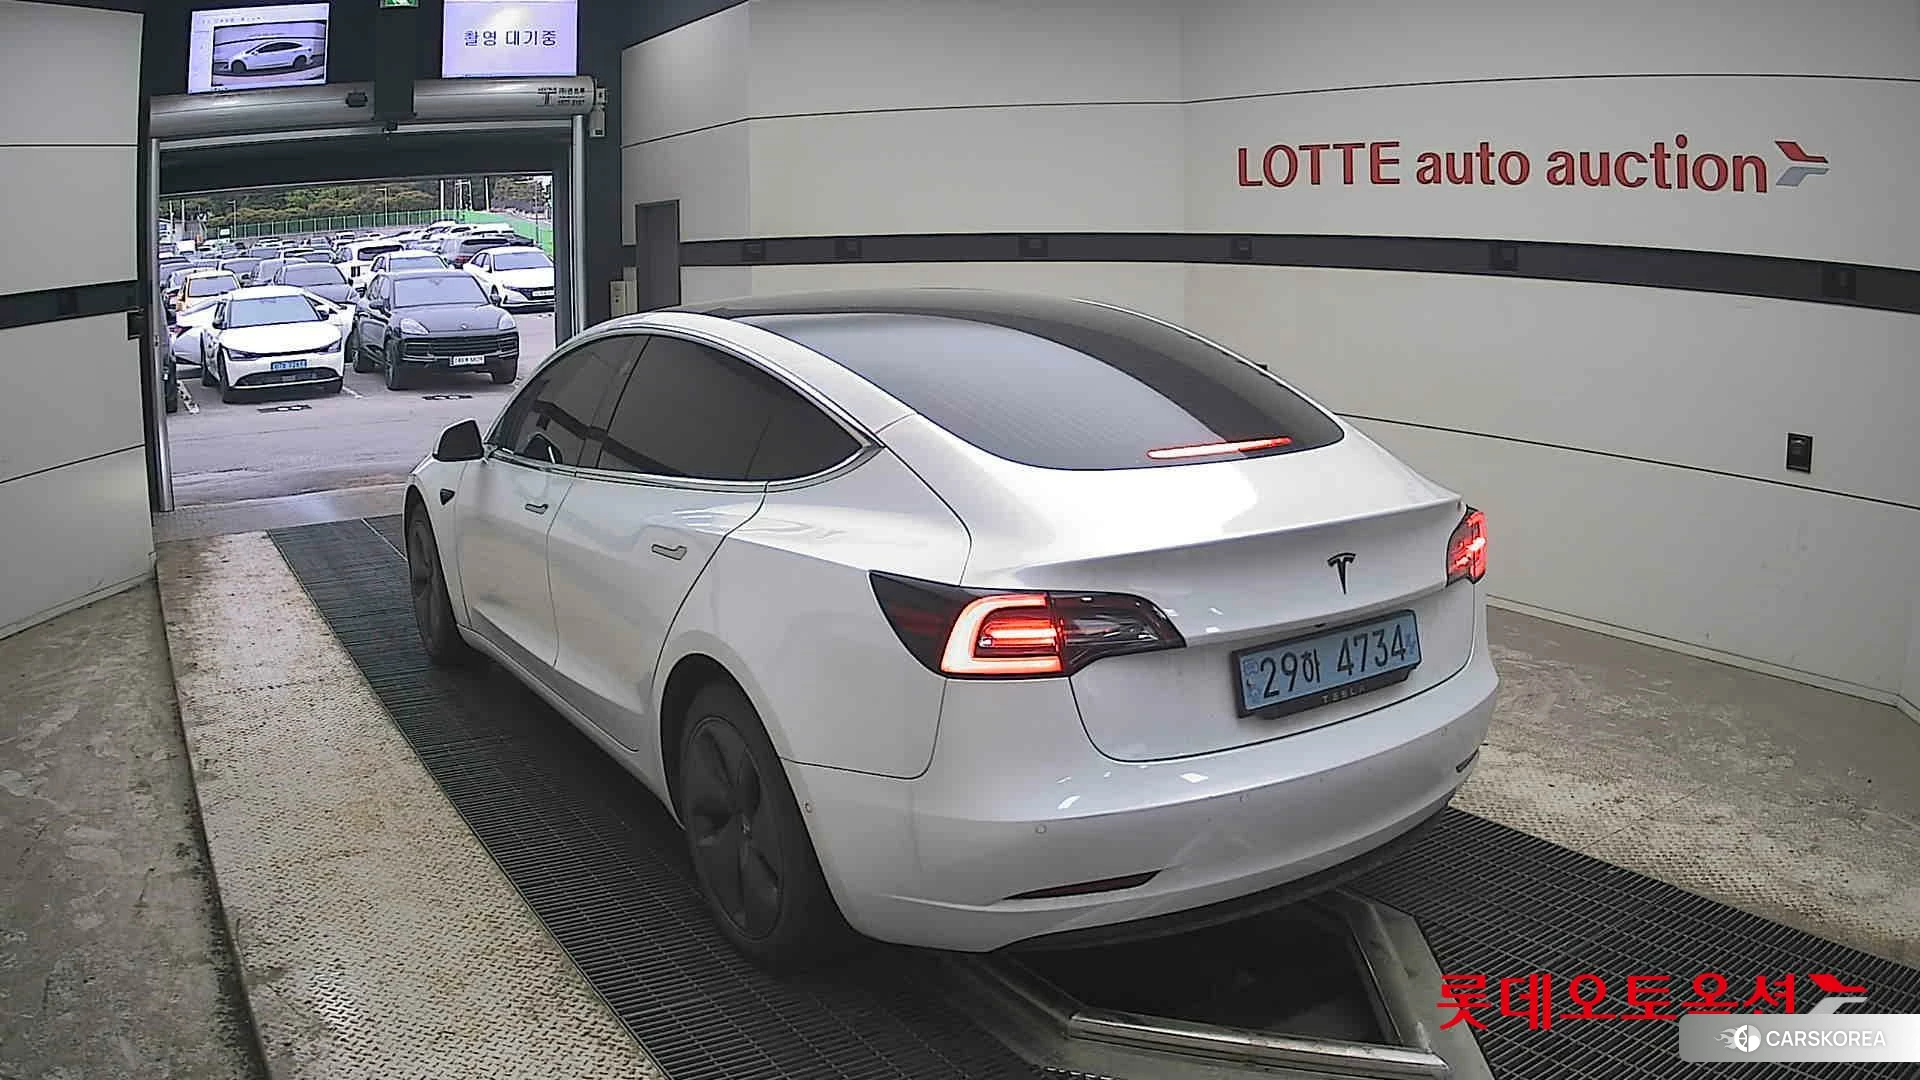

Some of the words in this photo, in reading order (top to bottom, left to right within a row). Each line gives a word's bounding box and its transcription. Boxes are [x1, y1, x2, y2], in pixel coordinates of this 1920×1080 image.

[505, 29, 557, 46] 대기중
[1237, 140, 1400, 188] LOTTE
[1415, 141, 1530, 187] auto
[1546, 133, 1768, 193] auction
[1260, 648, 1321, 699] 29하
[1336, 623, 1407, 676] 4734
